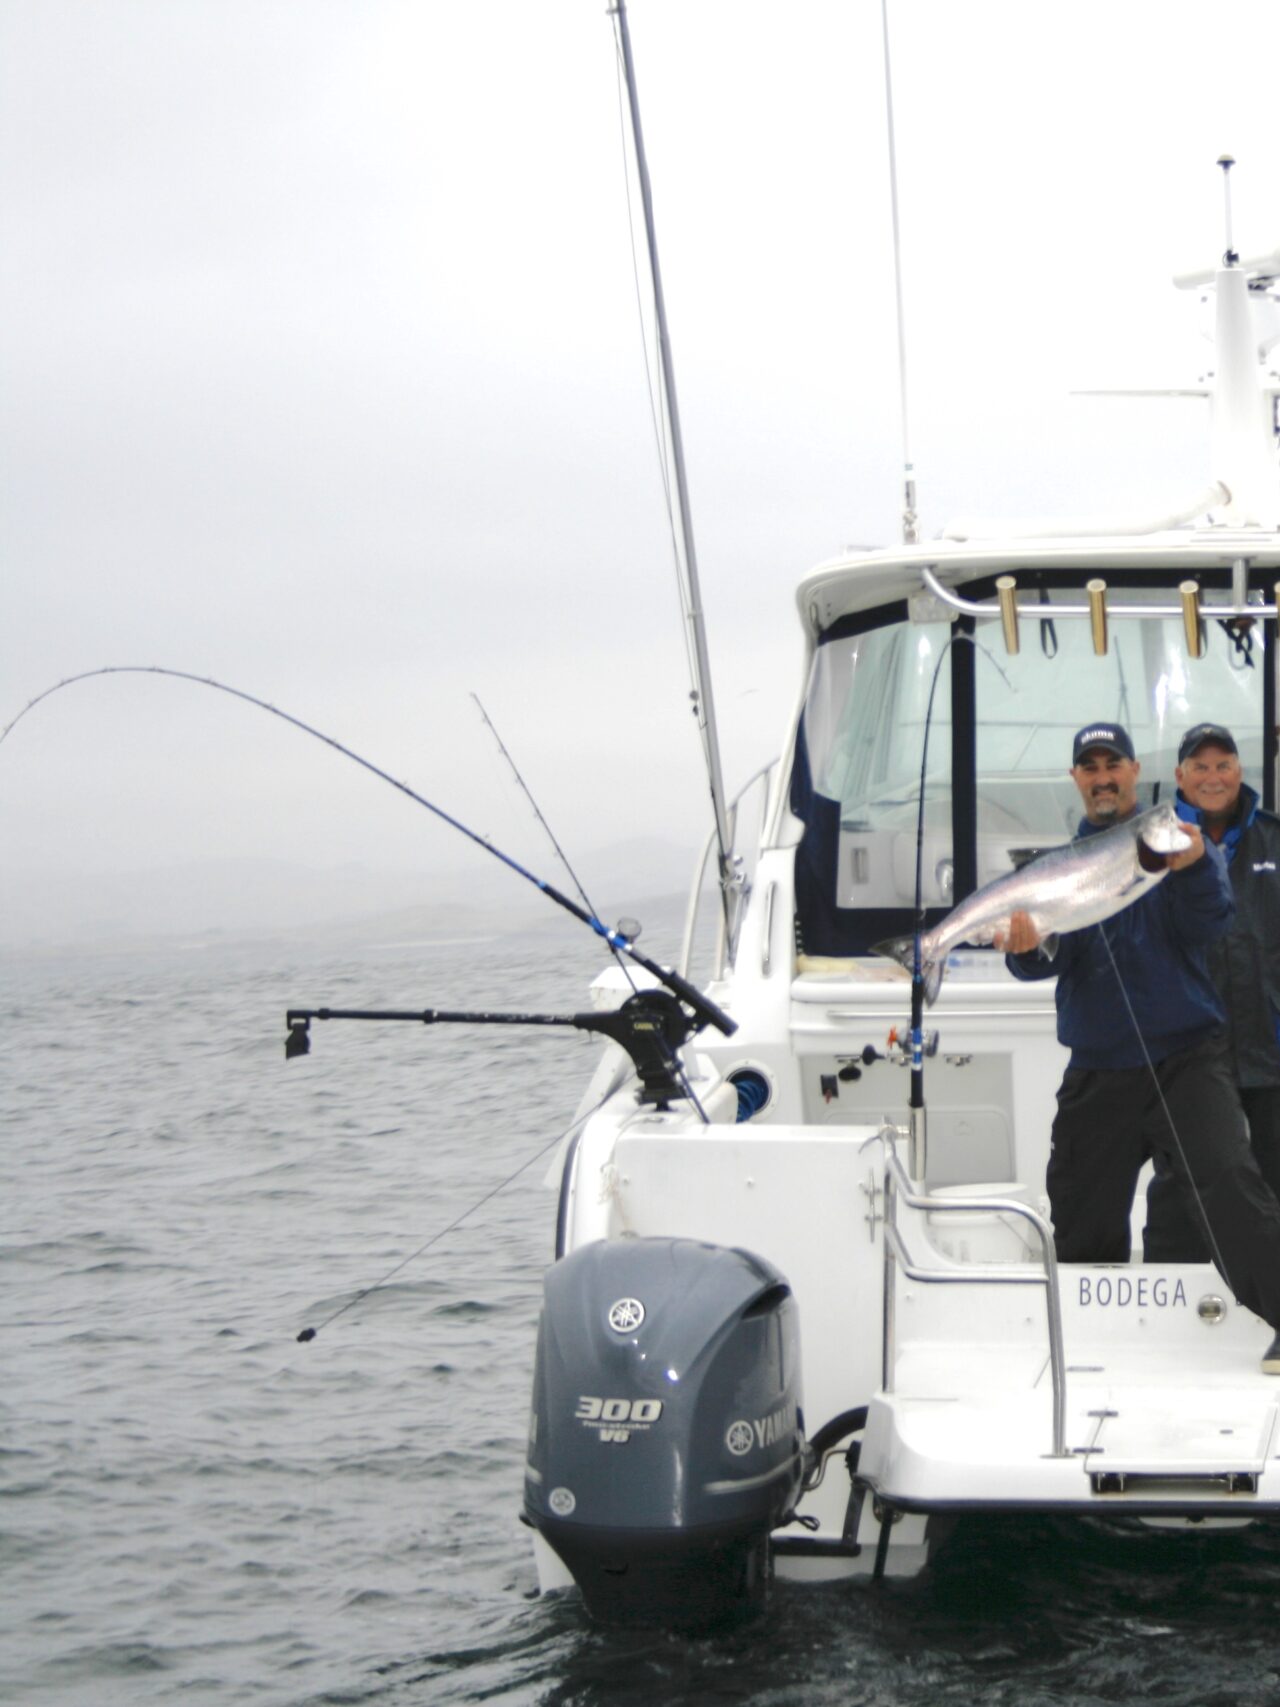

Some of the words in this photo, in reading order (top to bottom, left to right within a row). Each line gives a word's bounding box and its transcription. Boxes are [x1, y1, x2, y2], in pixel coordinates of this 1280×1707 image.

[1079, 1276, 1187, 1307] BODEGA
[575, 1396, 662, 1421] 300
[600, 1429, 630, 1442] V6
